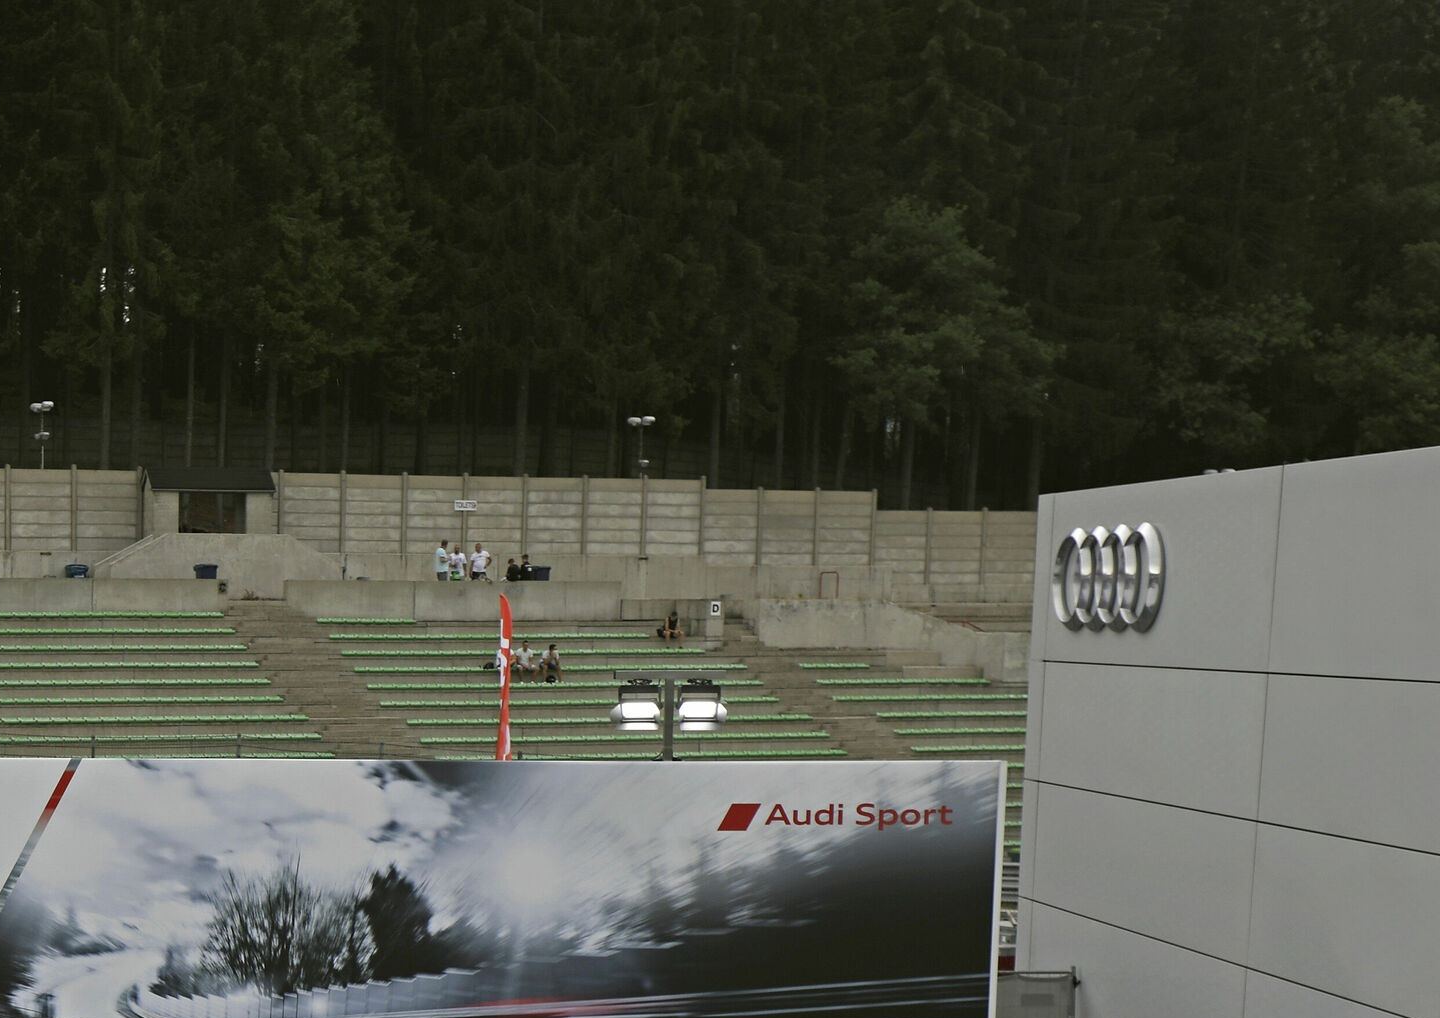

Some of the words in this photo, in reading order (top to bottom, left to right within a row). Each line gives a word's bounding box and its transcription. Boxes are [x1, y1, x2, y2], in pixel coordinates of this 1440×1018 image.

[712, 603, 720, 614] D
[764, 804, 844, 826] Audi
[856, 803, 954, 830] Sport
